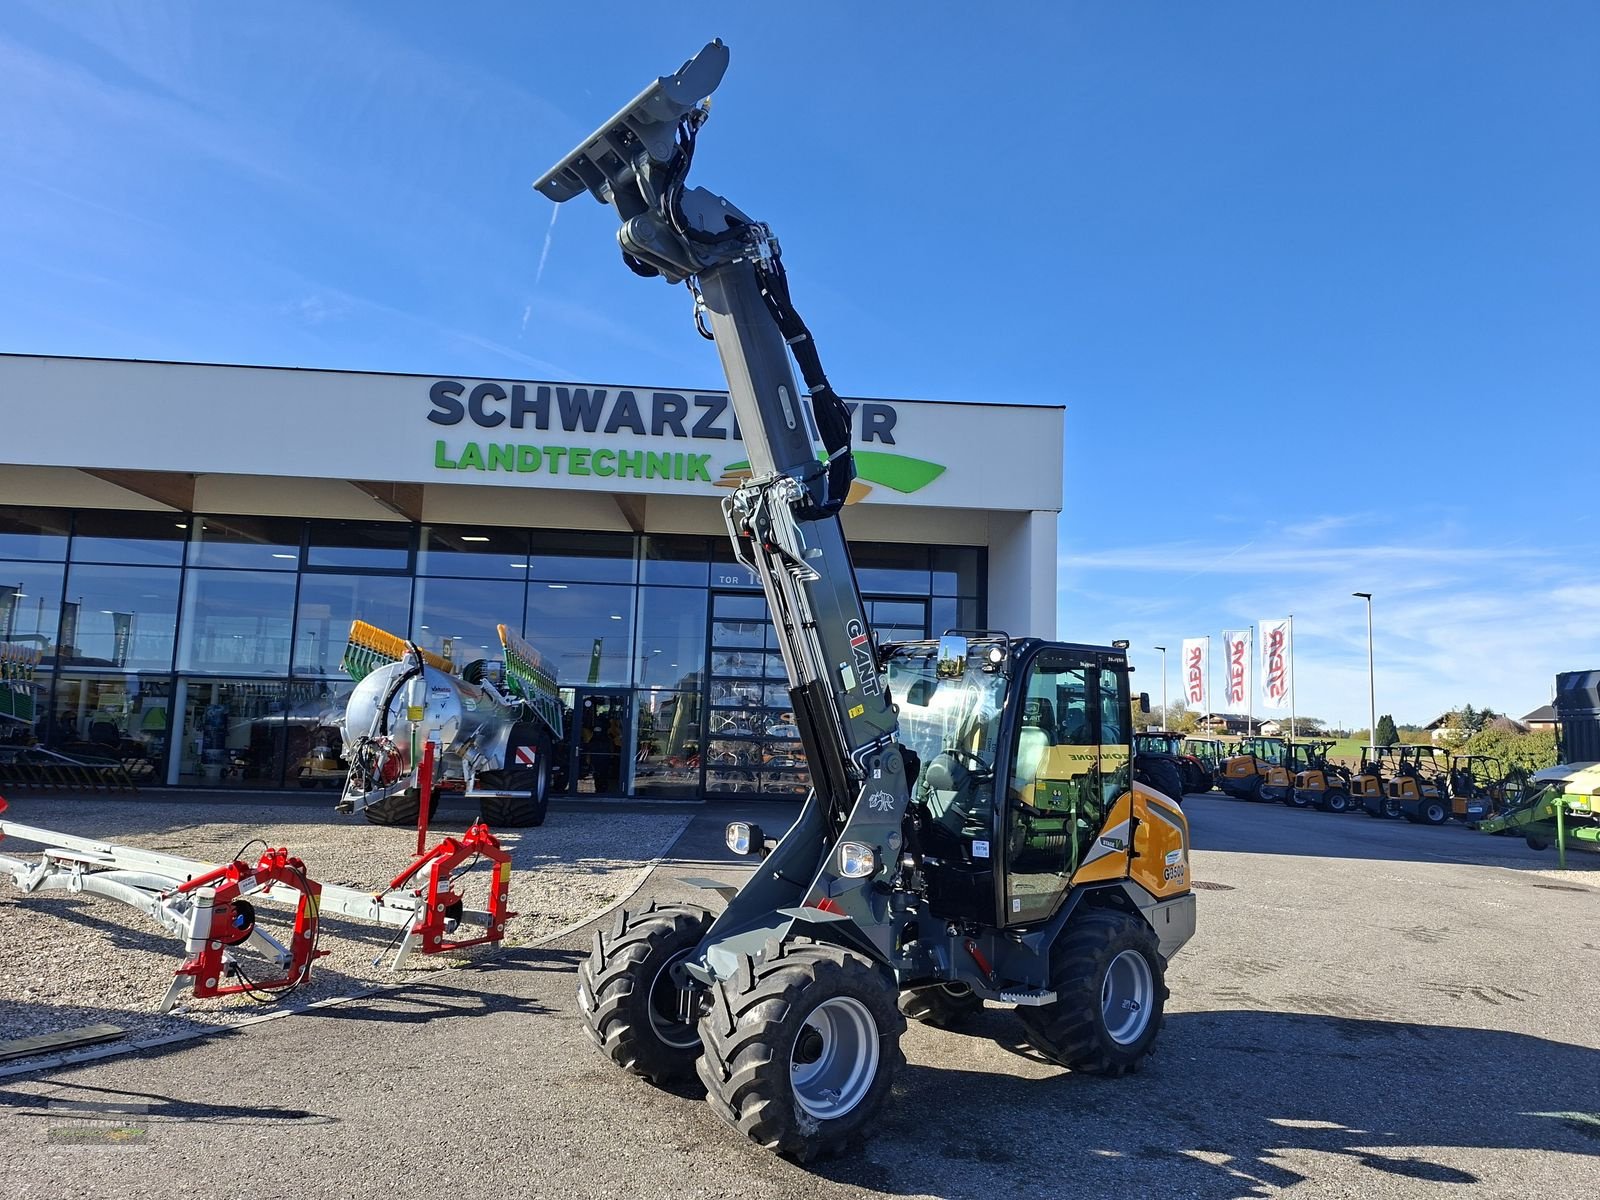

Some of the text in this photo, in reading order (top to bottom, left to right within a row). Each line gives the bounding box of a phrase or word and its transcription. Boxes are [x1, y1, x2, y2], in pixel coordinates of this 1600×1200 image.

[427, 381, 898, 445] SCHWARZR
[434, 439, 712, 482] LANDTECHNIK
[719, 576, 739, 584] TOR
[846, 618, 880, 696] GIANT
